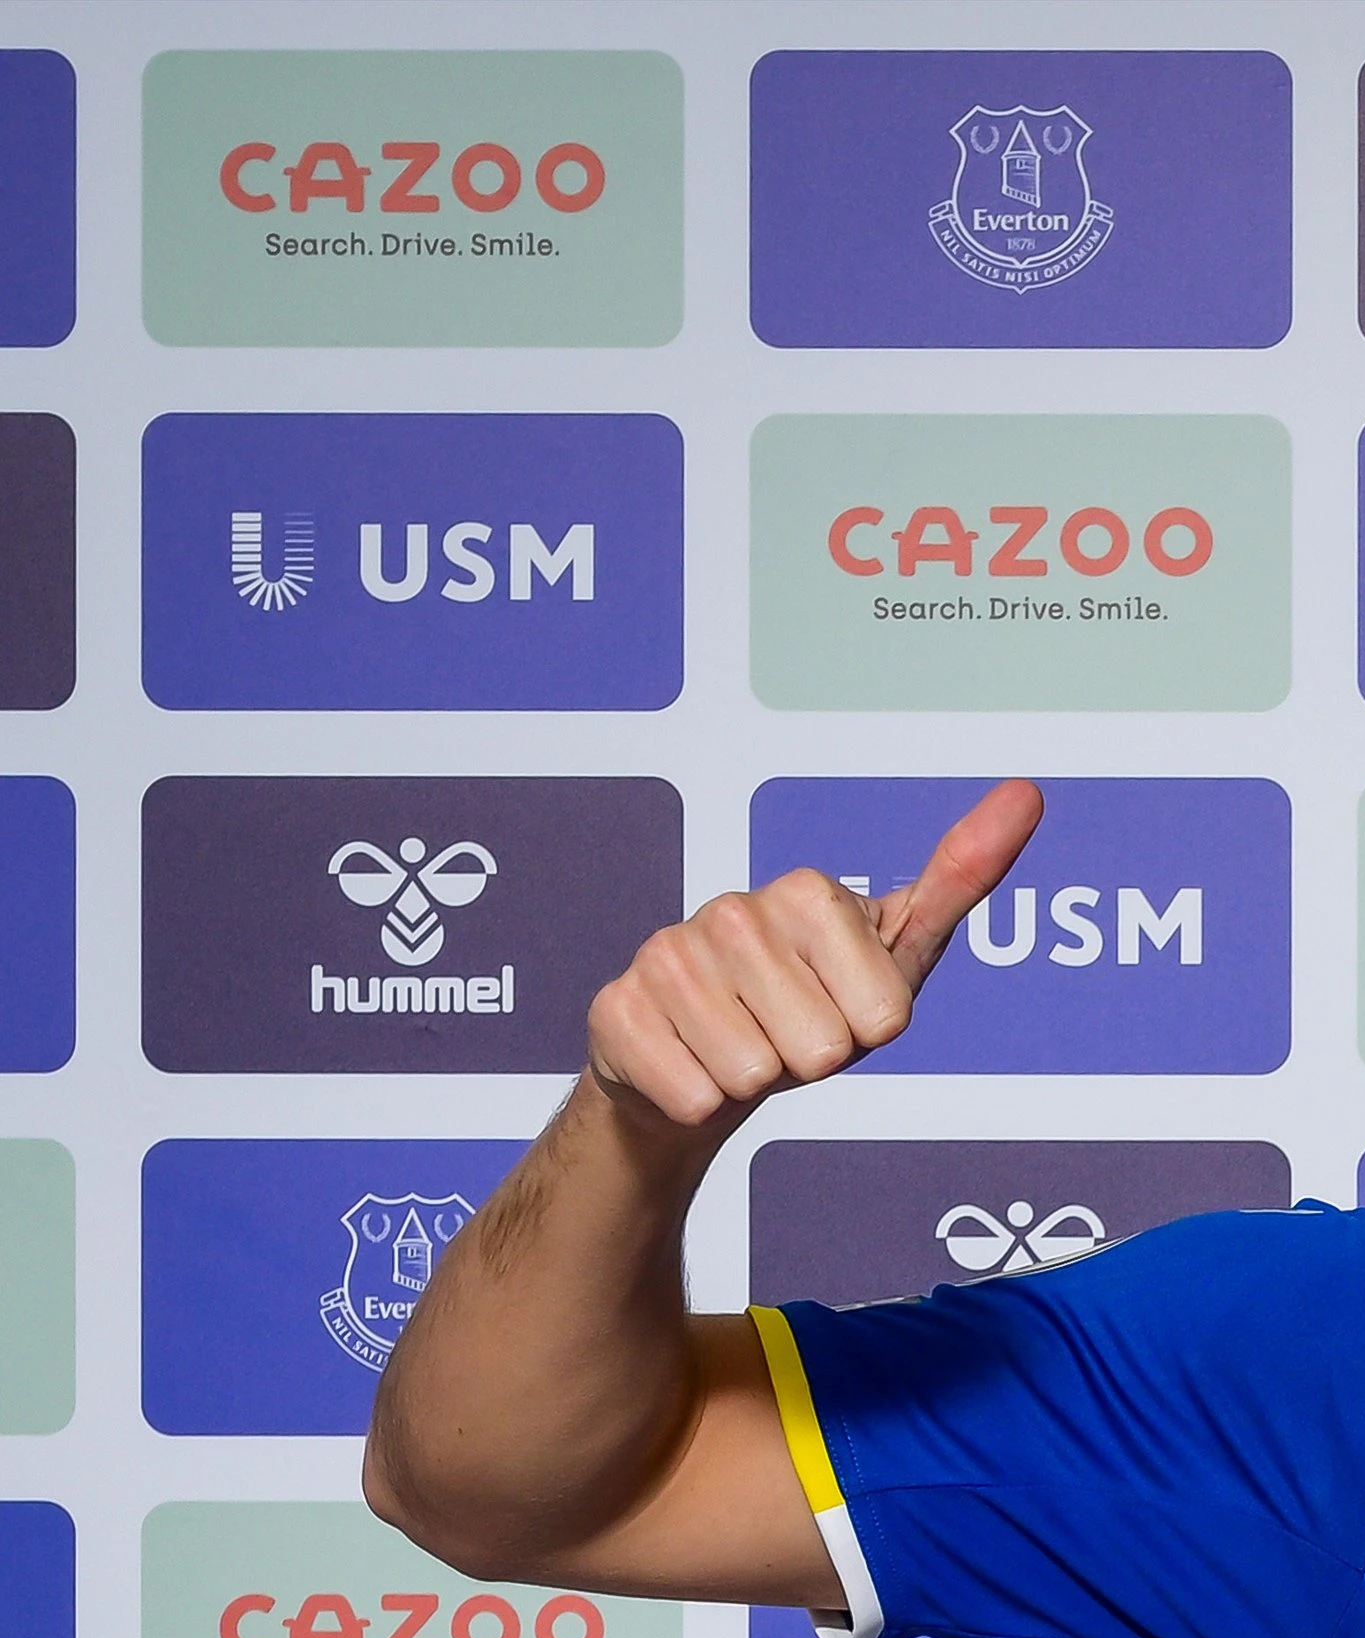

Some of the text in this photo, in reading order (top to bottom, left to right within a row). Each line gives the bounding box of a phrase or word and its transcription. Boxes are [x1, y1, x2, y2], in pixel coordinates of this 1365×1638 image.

[220, 142, 606, 213] CAZOO
[265, 232, 560, 256] Search. Drive. Smile.
[973, 208, 1069, 231] Everton
[940, 228, 1102, 283] NIL SATIS NISI OPTIMUM
[360, 522, 594, 602] USM
[828, 506, 1214, 577] CAZOO
[873, 596, 1168, 620] Search. Drive. Smile.
[968, 886, 1202, 966] USM
[311, 964, 514, 1013] hummel
[331, 1316, 350, 1343] NIL
[364, 1296, 416, 1319] Ever
